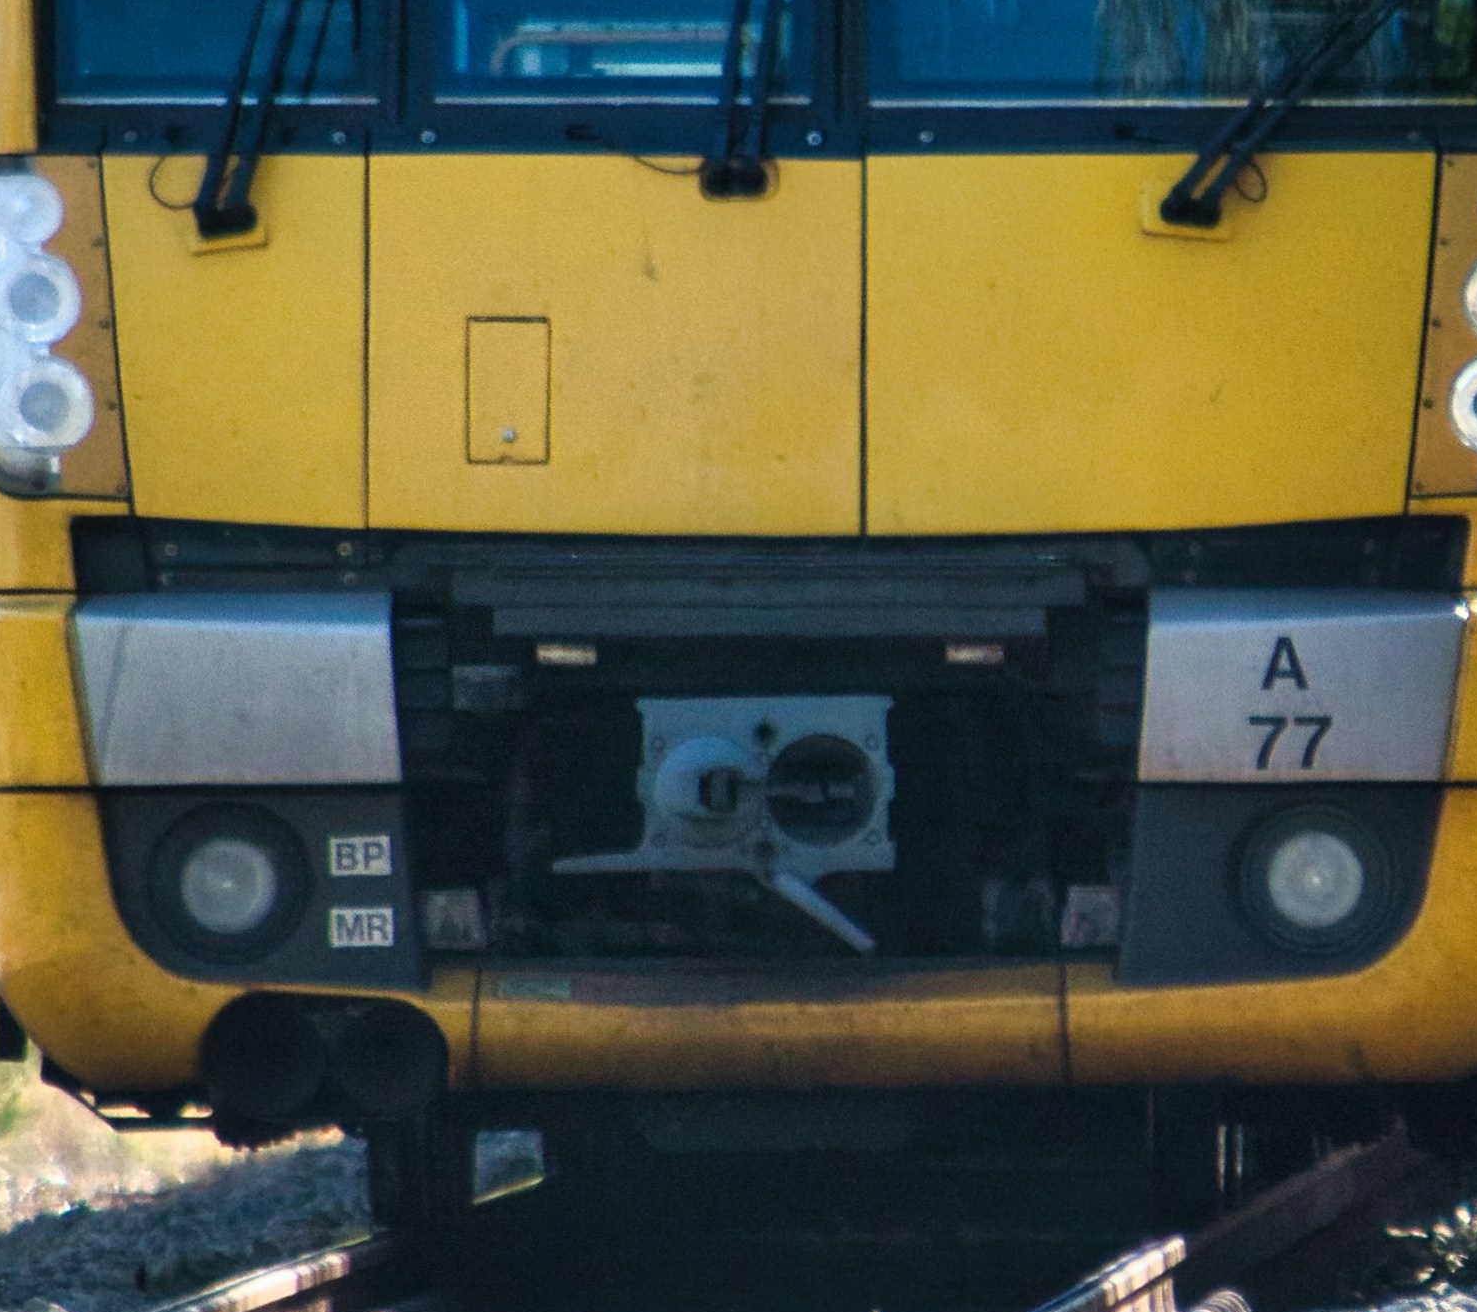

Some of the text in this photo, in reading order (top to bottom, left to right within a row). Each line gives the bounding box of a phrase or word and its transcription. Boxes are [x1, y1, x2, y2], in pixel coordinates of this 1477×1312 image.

[1260, 636, 1309, 690] A
[1248, 715, 1333, 770] 77
[334, 841, 386, 872] BP
[334, 912, 390, 942] MR
